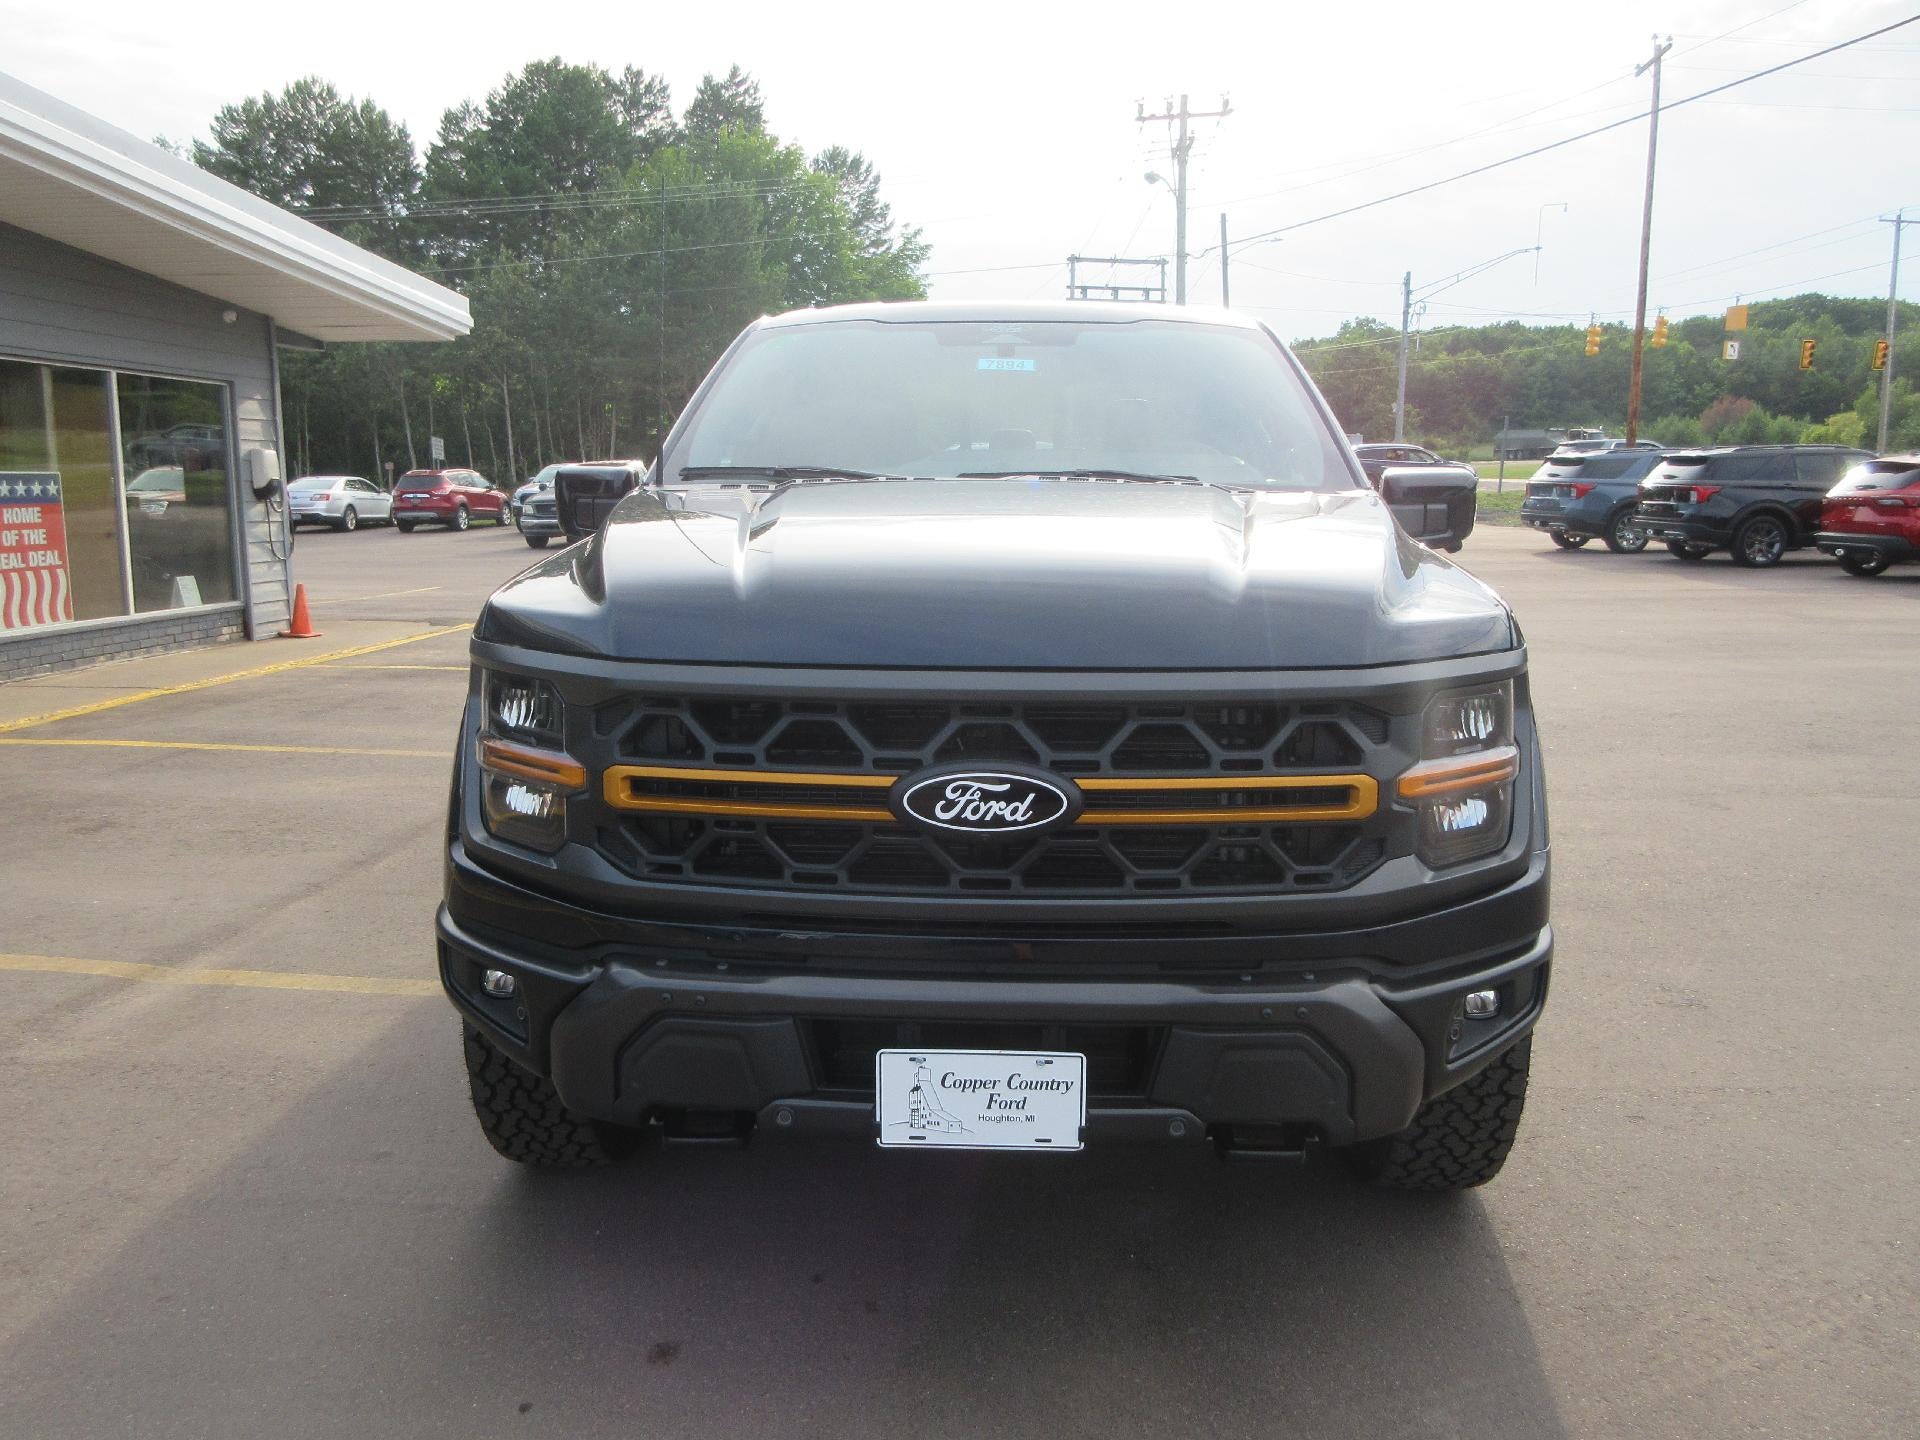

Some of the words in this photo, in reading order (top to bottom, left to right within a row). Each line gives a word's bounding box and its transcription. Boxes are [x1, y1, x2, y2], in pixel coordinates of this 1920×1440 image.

[3, 507, 42, 524] HOME
[3, 530, 19, 546] OF
[22, 529, 47, 545] THE
[0, 552, 25, 569] EAL
[29, 550, 63, 567] DEAL
[935, 781, 1036, 821] Ford
[940, 1072, 1001, 1093] Copper
[1007, 1073, 1074, 1094] Country
[986, 1093, 1027, 1110] Ford
[978, 1114, 1023, 1123] Houghton,
[1025, 1114, 1035, 1122] MI
